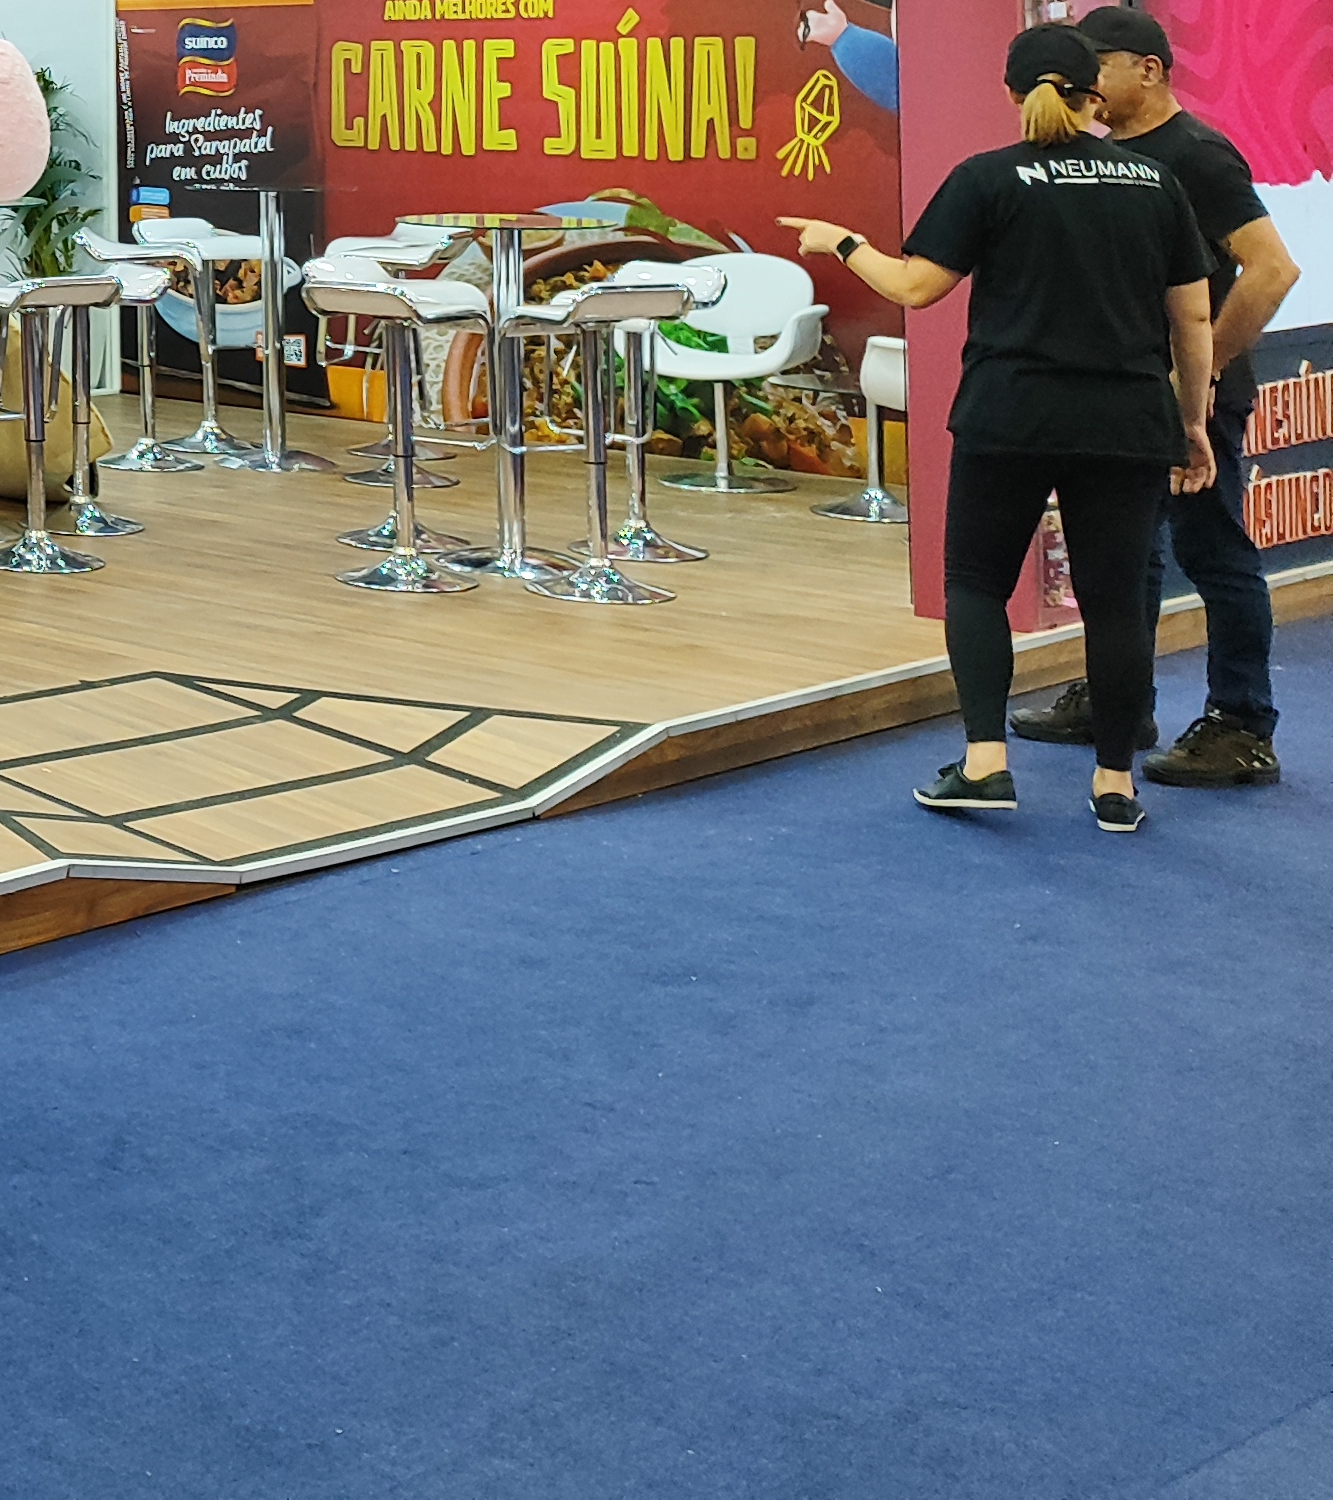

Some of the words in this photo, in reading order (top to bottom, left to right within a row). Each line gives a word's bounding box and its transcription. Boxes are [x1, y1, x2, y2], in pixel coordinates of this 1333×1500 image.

[384, 0, 432, 21] AINDA
[184, 34, 227, 49] suinco
[331, 38, 518, 155] CARNE
[541, 8, 757, 161] SUÍNA!
[165, 107, 263, 141] Ingredientes
[146, 143, 184, 165] para
[190, 126, 275, 166] Sarapatel
[173, 166, 198, 180] em
[202, 157, 248, 181] cubos
[1049, 159, 1160, 182] NEUMANN
